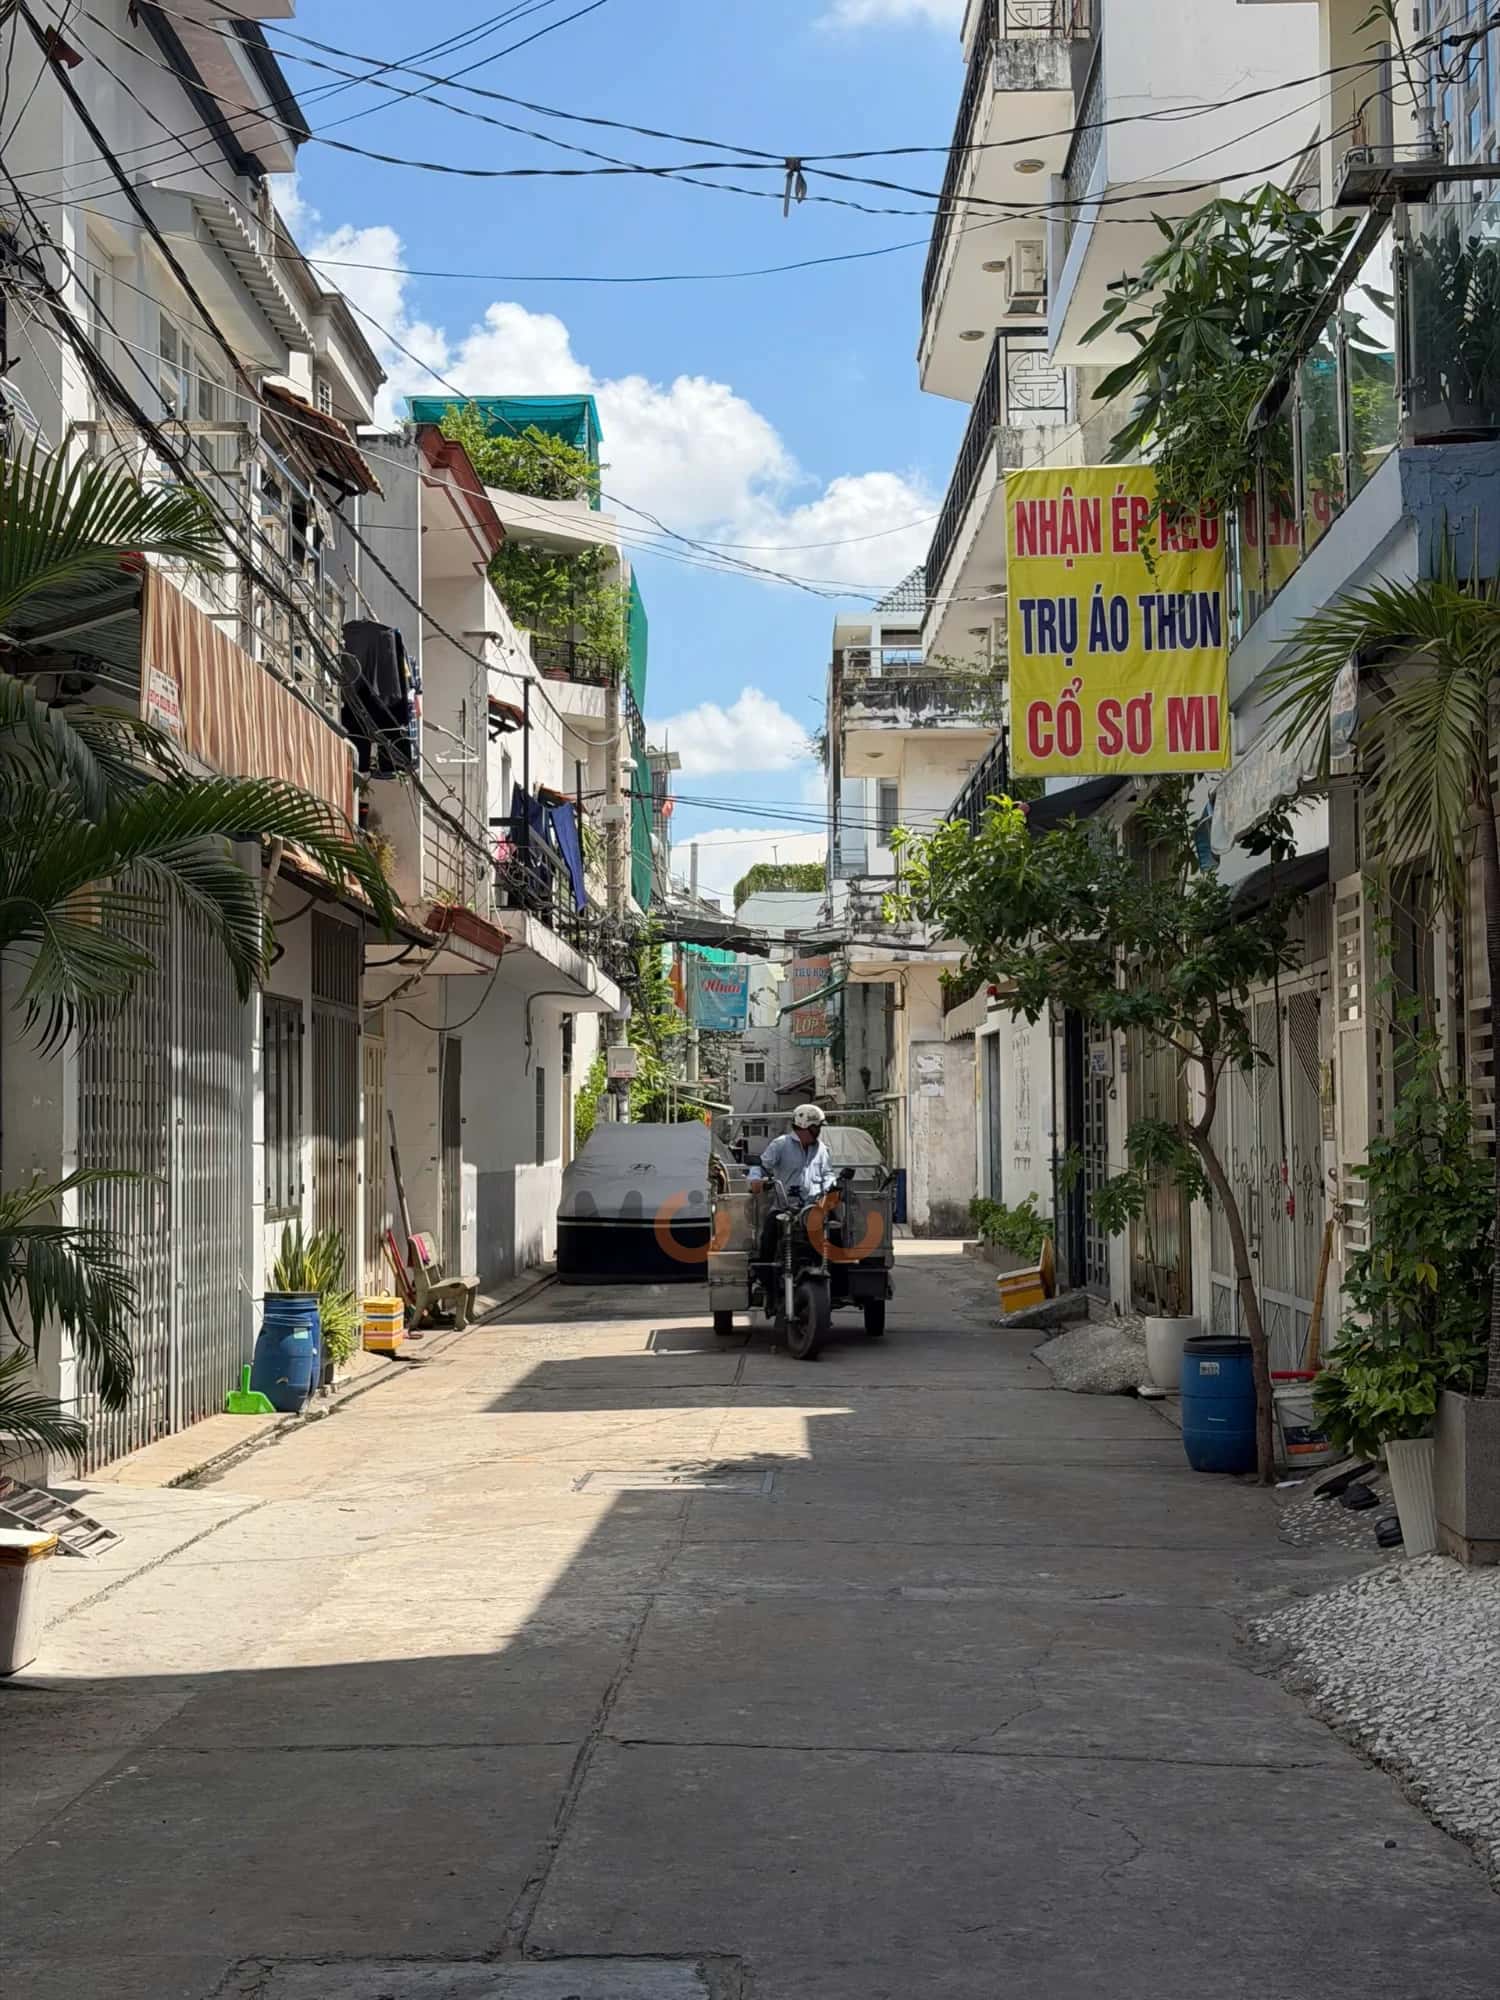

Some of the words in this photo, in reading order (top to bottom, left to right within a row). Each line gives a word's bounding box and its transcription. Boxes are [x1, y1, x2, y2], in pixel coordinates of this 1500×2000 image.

[1016, 486, 1102, 568] NHẬN
[1111, 484, 1149, 553] ÉP
[1018, 597, 1078, 667] TRỤ
[1088, 583, 1129, 653] ÁO
[1138, 591, 1221, 651] THUN
[1027, 677, 1083, 759] CỔ
[1097, 692, 1153, 756] SƠ
[1167, 695, 1220, 753] MI
